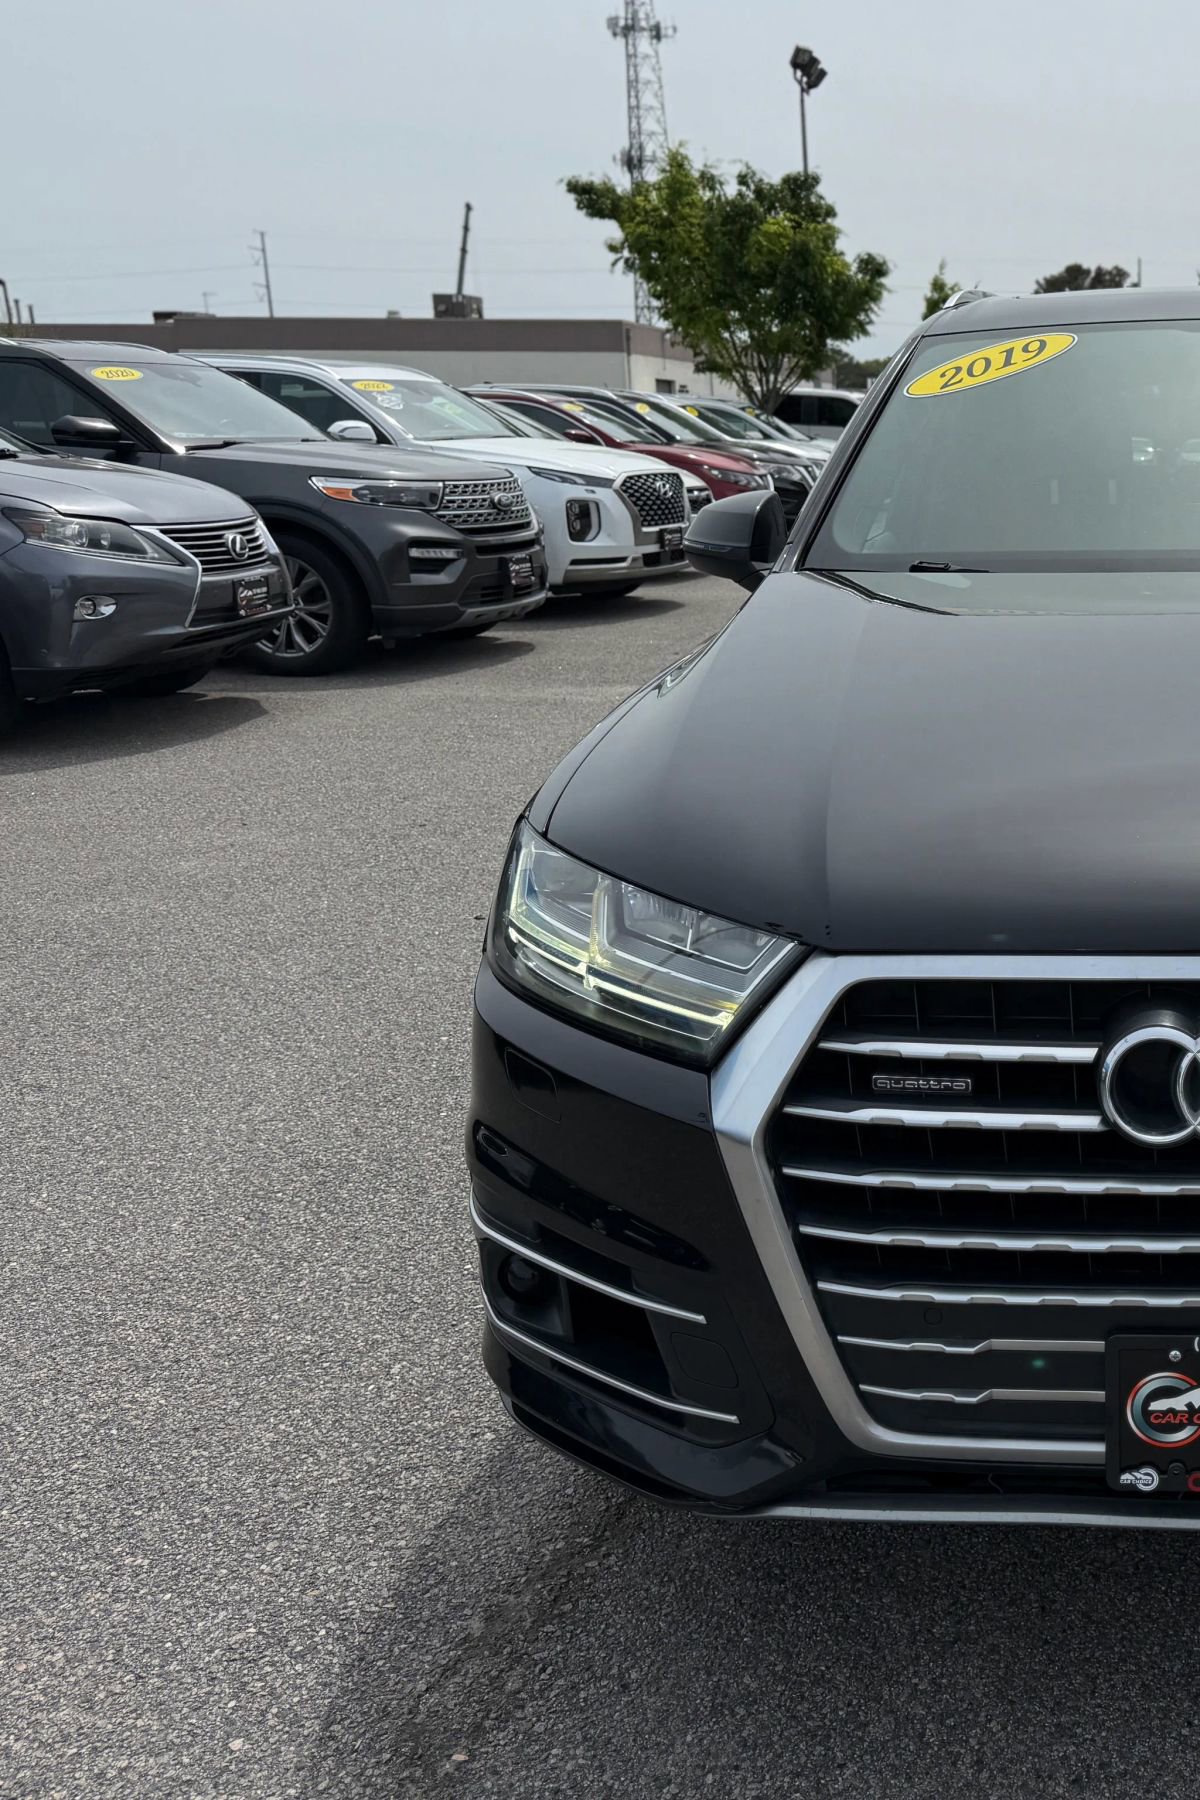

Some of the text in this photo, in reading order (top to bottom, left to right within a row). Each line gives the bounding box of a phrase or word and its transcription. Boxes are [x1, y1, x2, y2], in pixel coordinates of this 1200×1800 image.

[939, 338, 1048, 390] 2019
[100, 369, 136, 378] 2020
[876, 1079, 966, 1090] quattro
[1150, 1412, 1189, 1424] CAR
